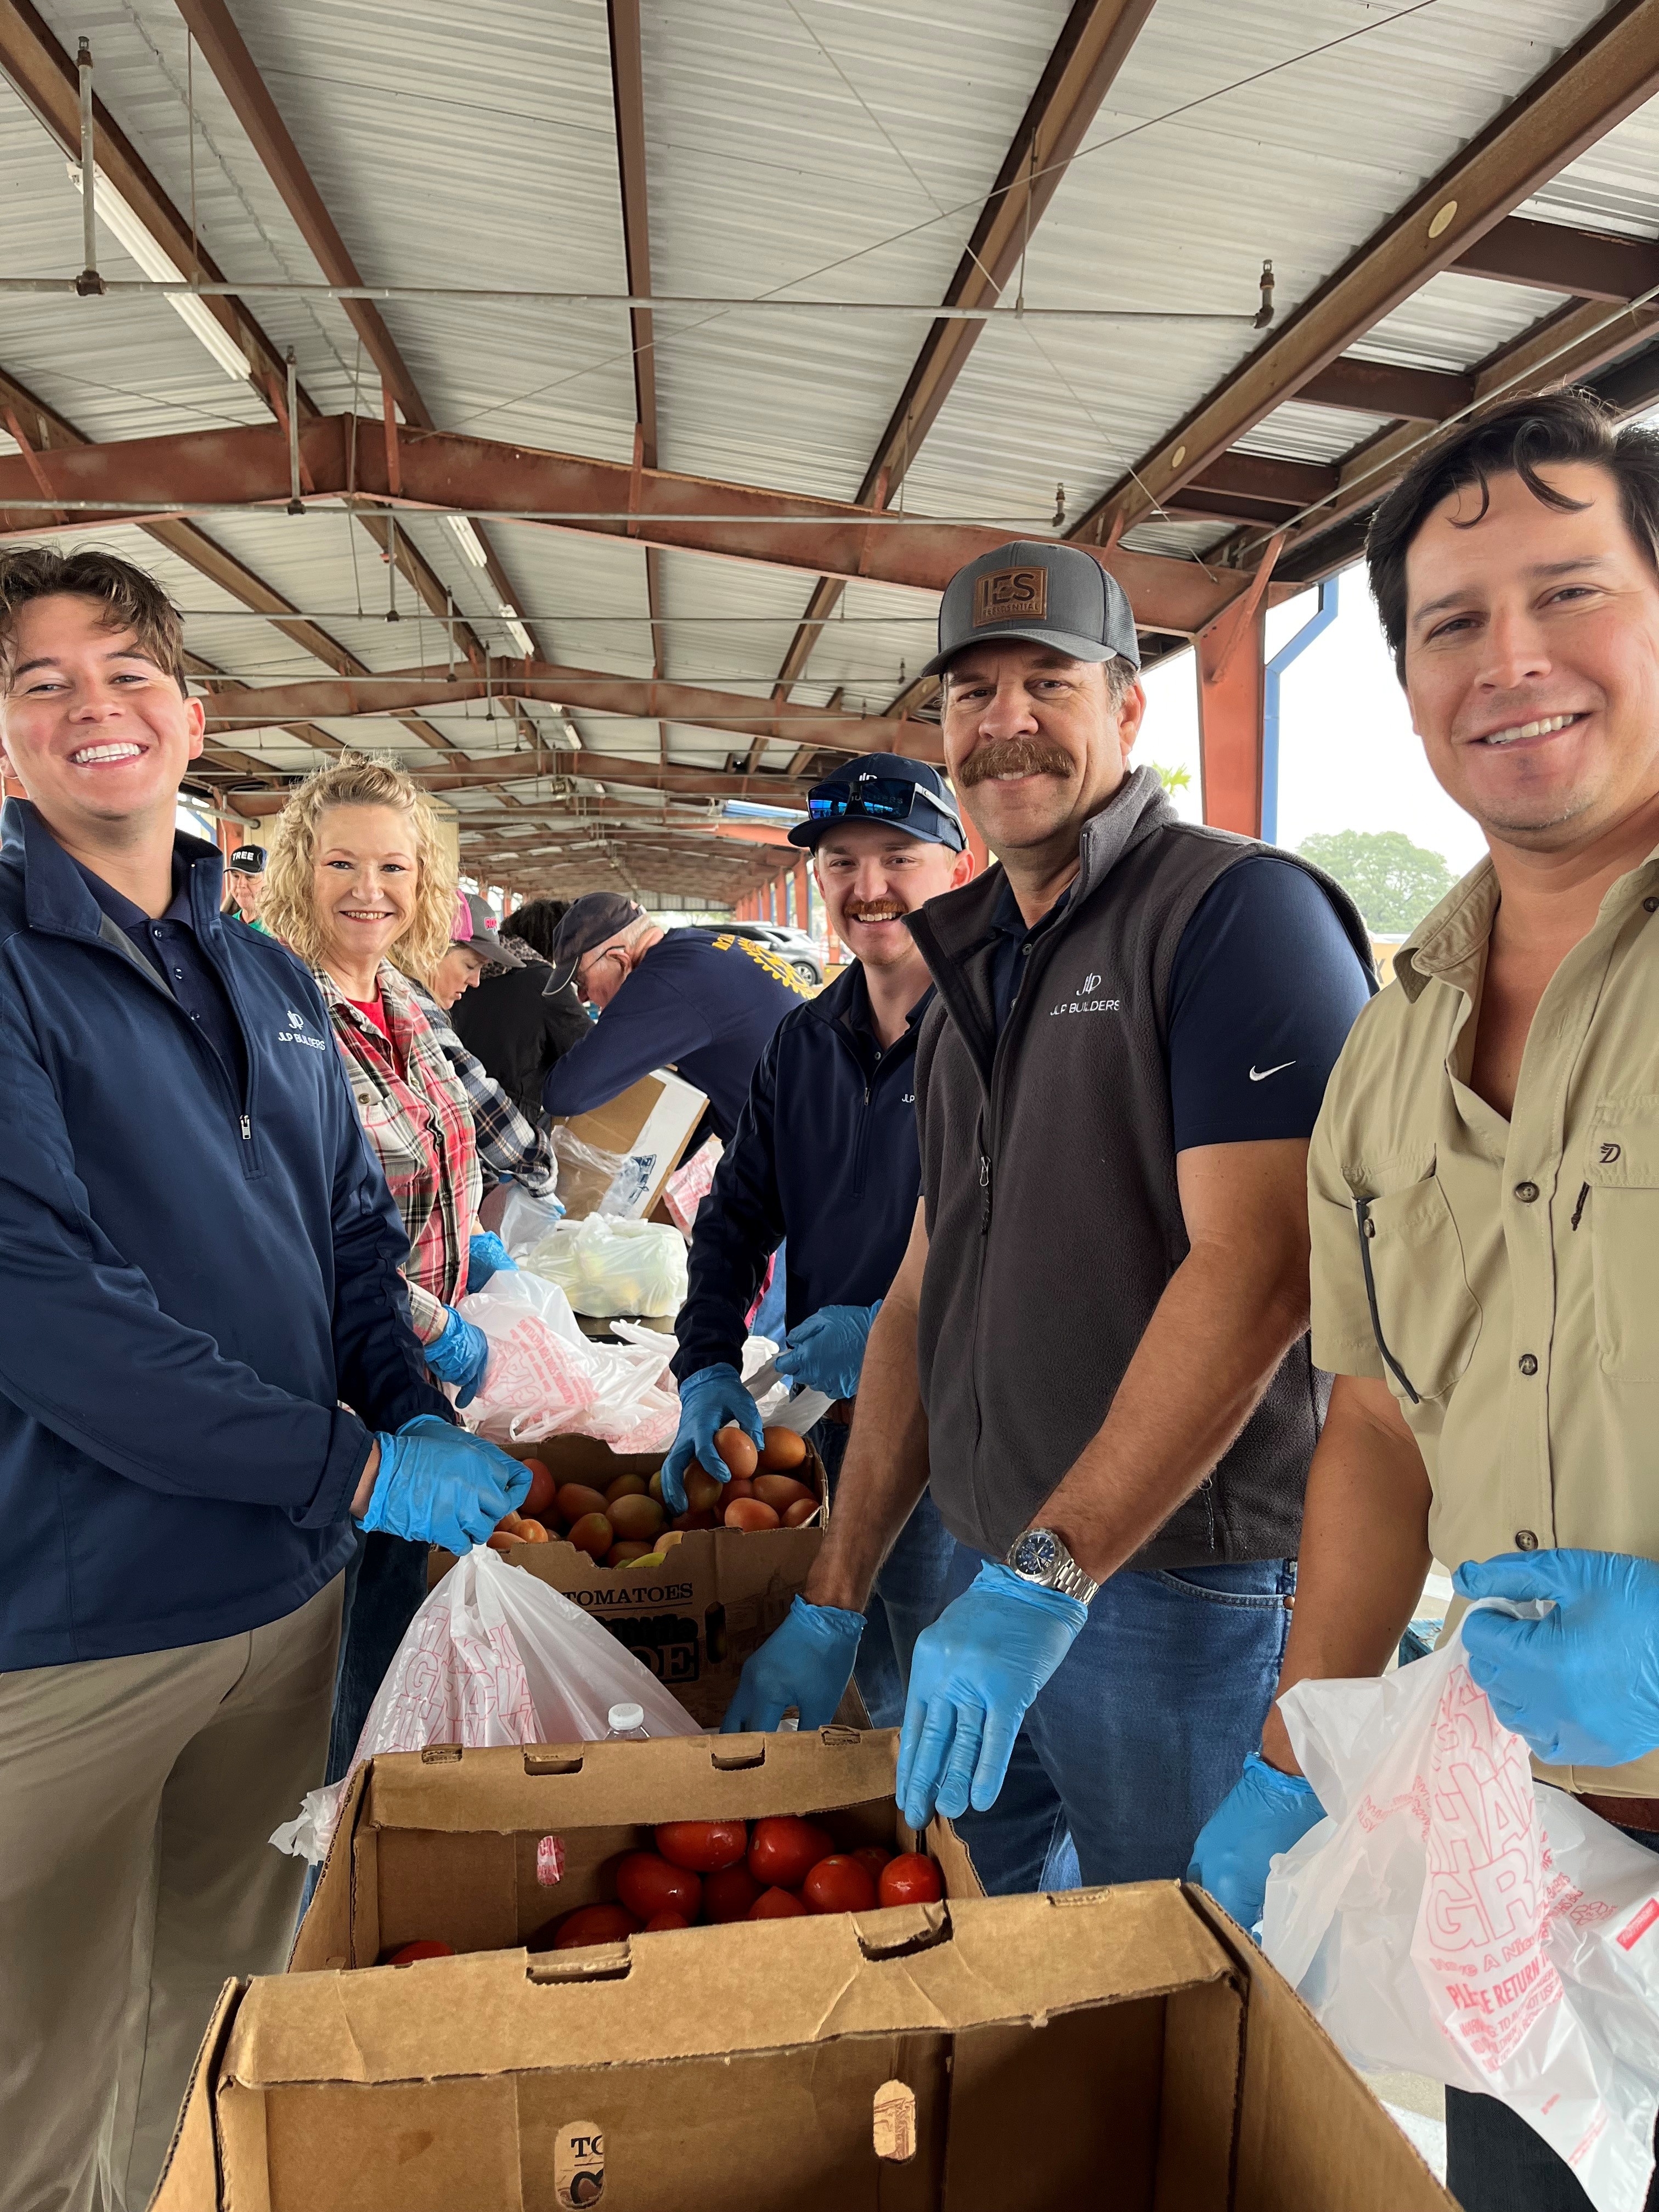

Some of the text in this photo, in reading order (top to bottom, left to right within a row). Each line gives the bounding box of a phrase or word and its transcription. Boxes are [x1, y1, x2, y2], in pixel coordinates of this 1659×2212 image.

[232, 851, 254, 861] TREE
[1050, 1000, 1120, 1015] JLP BUILDERS
[901, 1093, 915, 1103] JLP
[1492, 1955, 1541, 2008] RETURN
